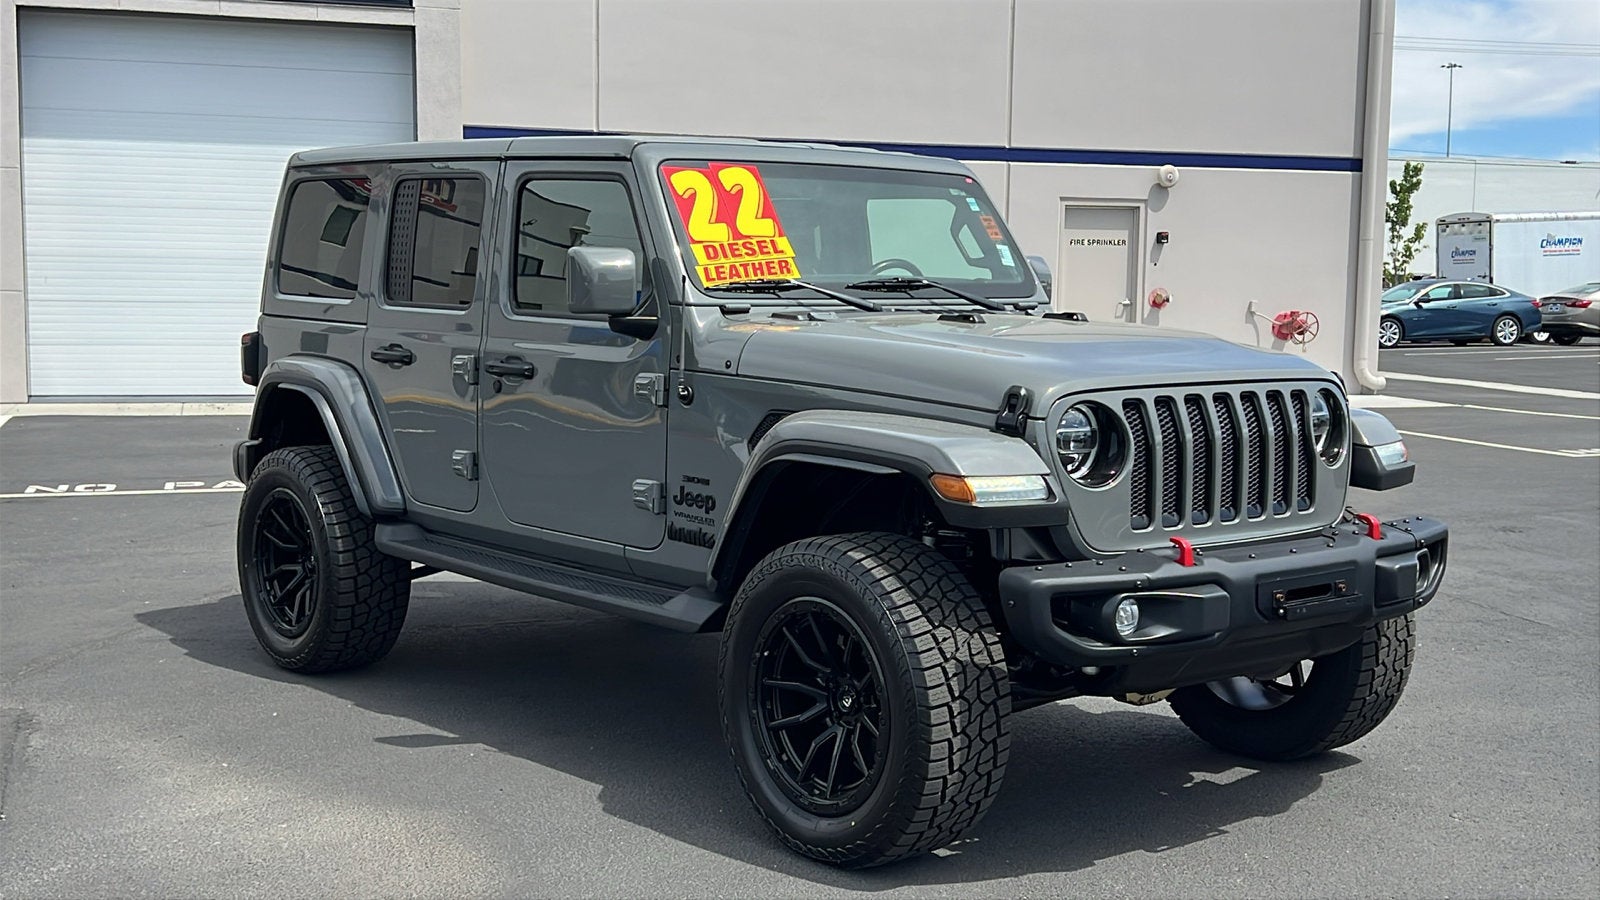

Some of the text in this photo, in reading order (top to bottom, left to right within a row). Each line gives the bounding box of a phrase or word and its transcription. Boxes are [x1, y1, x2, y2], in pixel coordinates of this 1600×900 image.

[670, 166, 779, 243] 22
[703, 239, 785, 261] DIESEL
[1070, 238, 1127, 246] FIRE SPRINKLER
[1540, 237, 1583, 248] CHAMPION
[703, 260, 793, 282] LEATHER
[24, 483, 117, 494] NO
[673, 485, 716, 515] Jeep
[673, 510, 715, 524] WRANGLER
